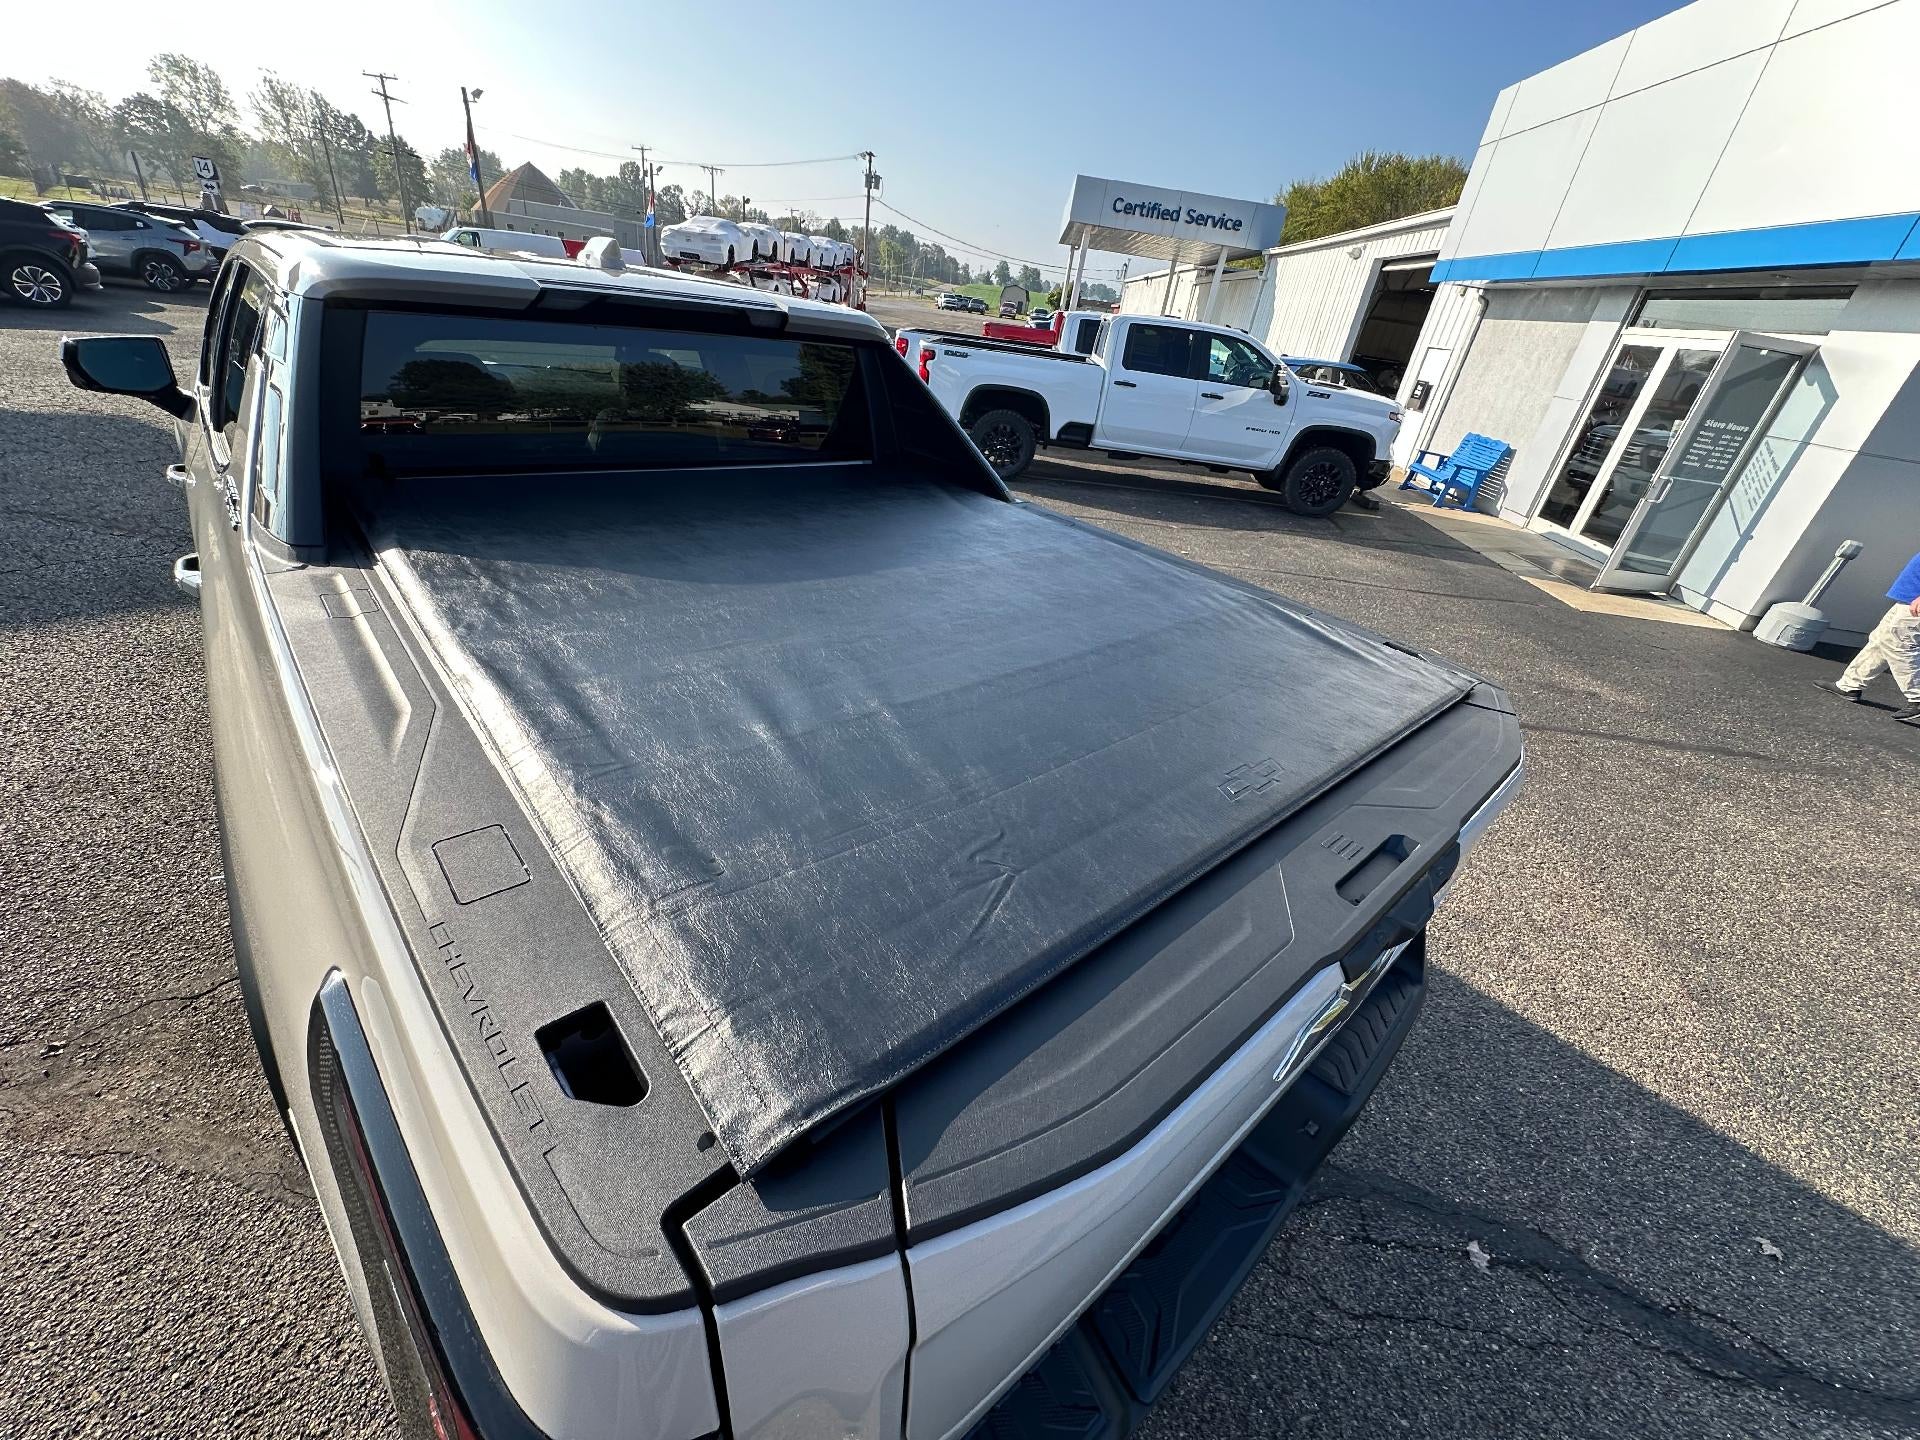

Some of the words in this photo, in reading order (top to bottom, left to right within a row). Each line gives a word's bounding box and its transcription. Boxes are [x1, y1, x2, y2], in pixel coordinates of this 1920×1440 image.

[197, 161, 210, 174] 14
[1112, 197, 1181, 222] Certified
[1185, 208, 1243, 231] Service
[1704, 419, 1726, 429] Store
[1726, 422, 1750, 432] Hours
[429, 921, 555, 1137] CHEVROLET
